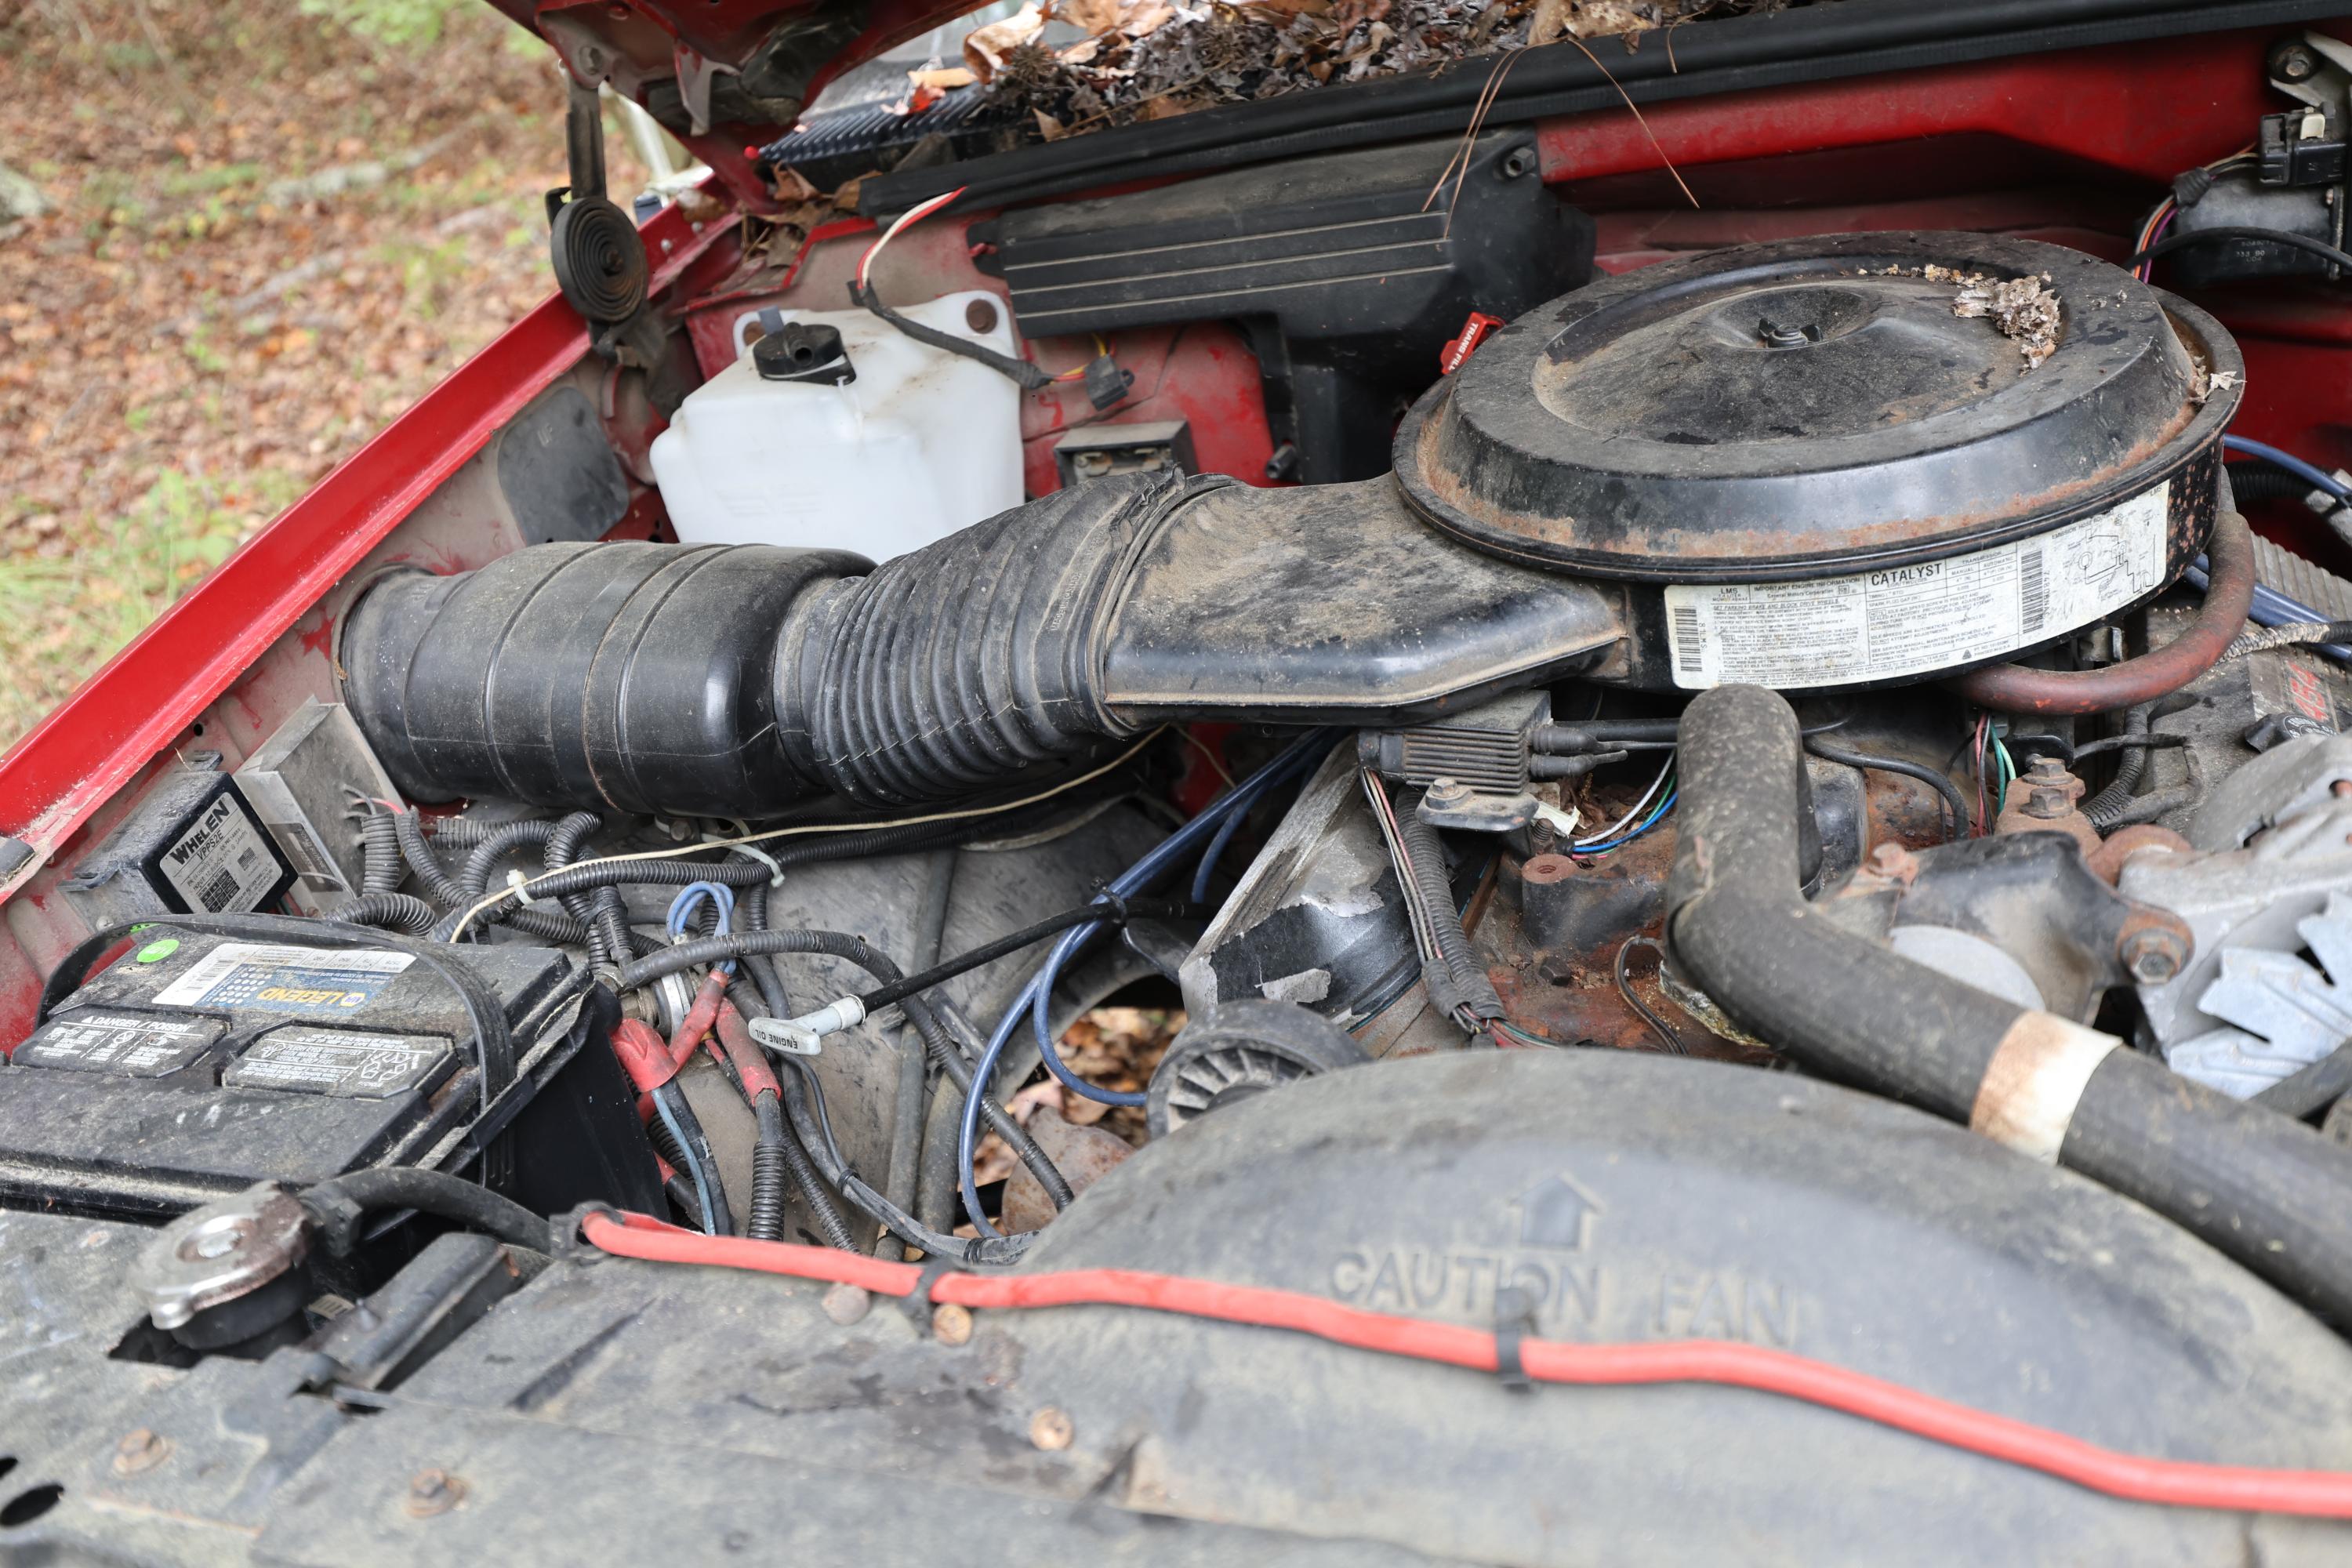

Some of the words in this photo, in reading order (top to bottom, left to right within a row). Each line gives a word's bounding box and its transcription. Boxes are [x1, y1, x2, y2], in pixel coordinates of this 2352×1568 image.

[1459, 322, 1479, 354] TRANS
[1448, 353, 1463, 371] FILL
[1817, 577, 1860, 586] INFORMATION
[1871, 563, 1942, 586] CATALYST
[169, 800, 230, 866] WHELEN
[197, 829, 224, 861] VPPS2E
[257, 987, 347, 1004] LEGEND
[93, 1017, 140, 1029] DANGER
[147, 1022, 191, 1033] POISON
[755, 1029, 766, 1040] OIL
[768, 1033, 798, 1049] ENGINE
[1330, 1250, 1601, 1325] CAUTION
[1657, 1270, 1797, 1345] FAN
